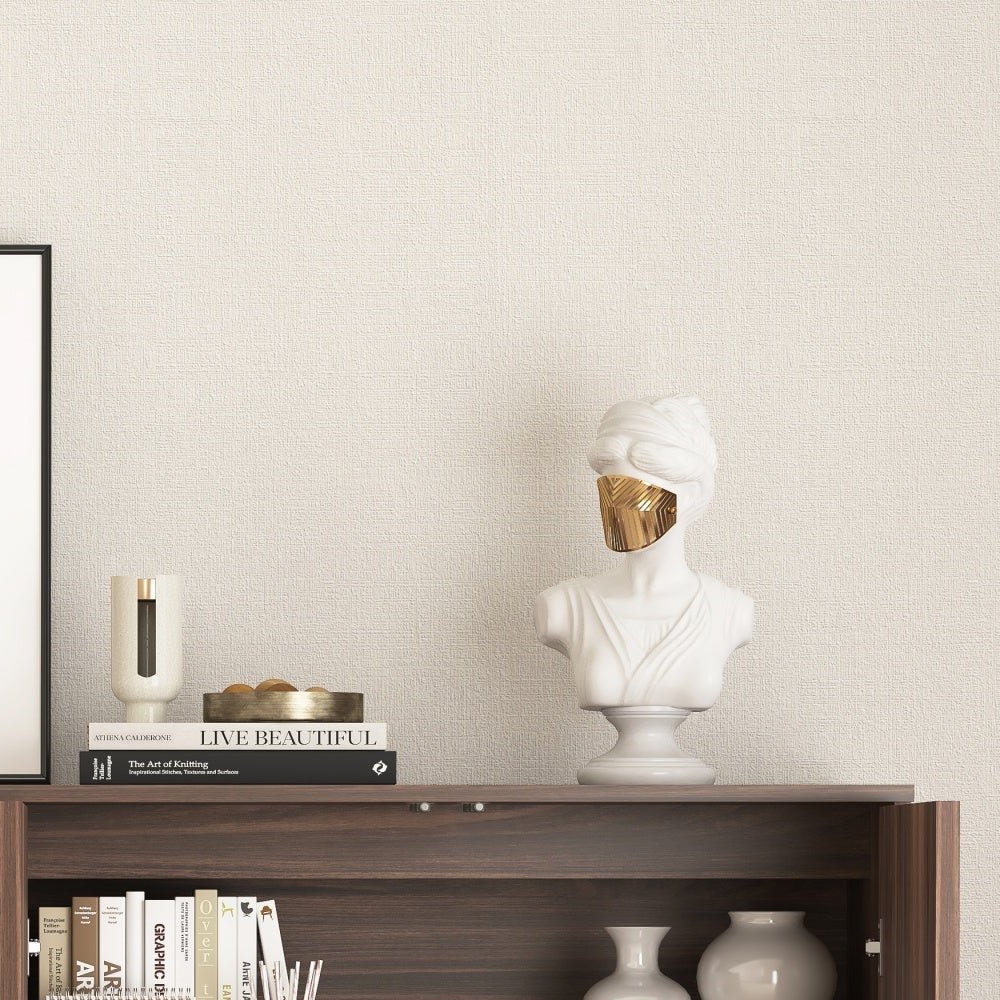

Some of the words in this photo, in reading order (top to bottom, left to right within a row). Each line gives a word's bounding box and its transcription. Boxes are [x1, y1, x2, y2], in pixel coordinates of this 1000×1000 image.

[200, 730, 248, 746] LIVE
[254, 730, 377, 746] BEAUTIFUL
[174, 760, 208, 770] Knitting
[200, 899, 213, 962] Over
[154, 924, 165, 980] GRAPHIC
